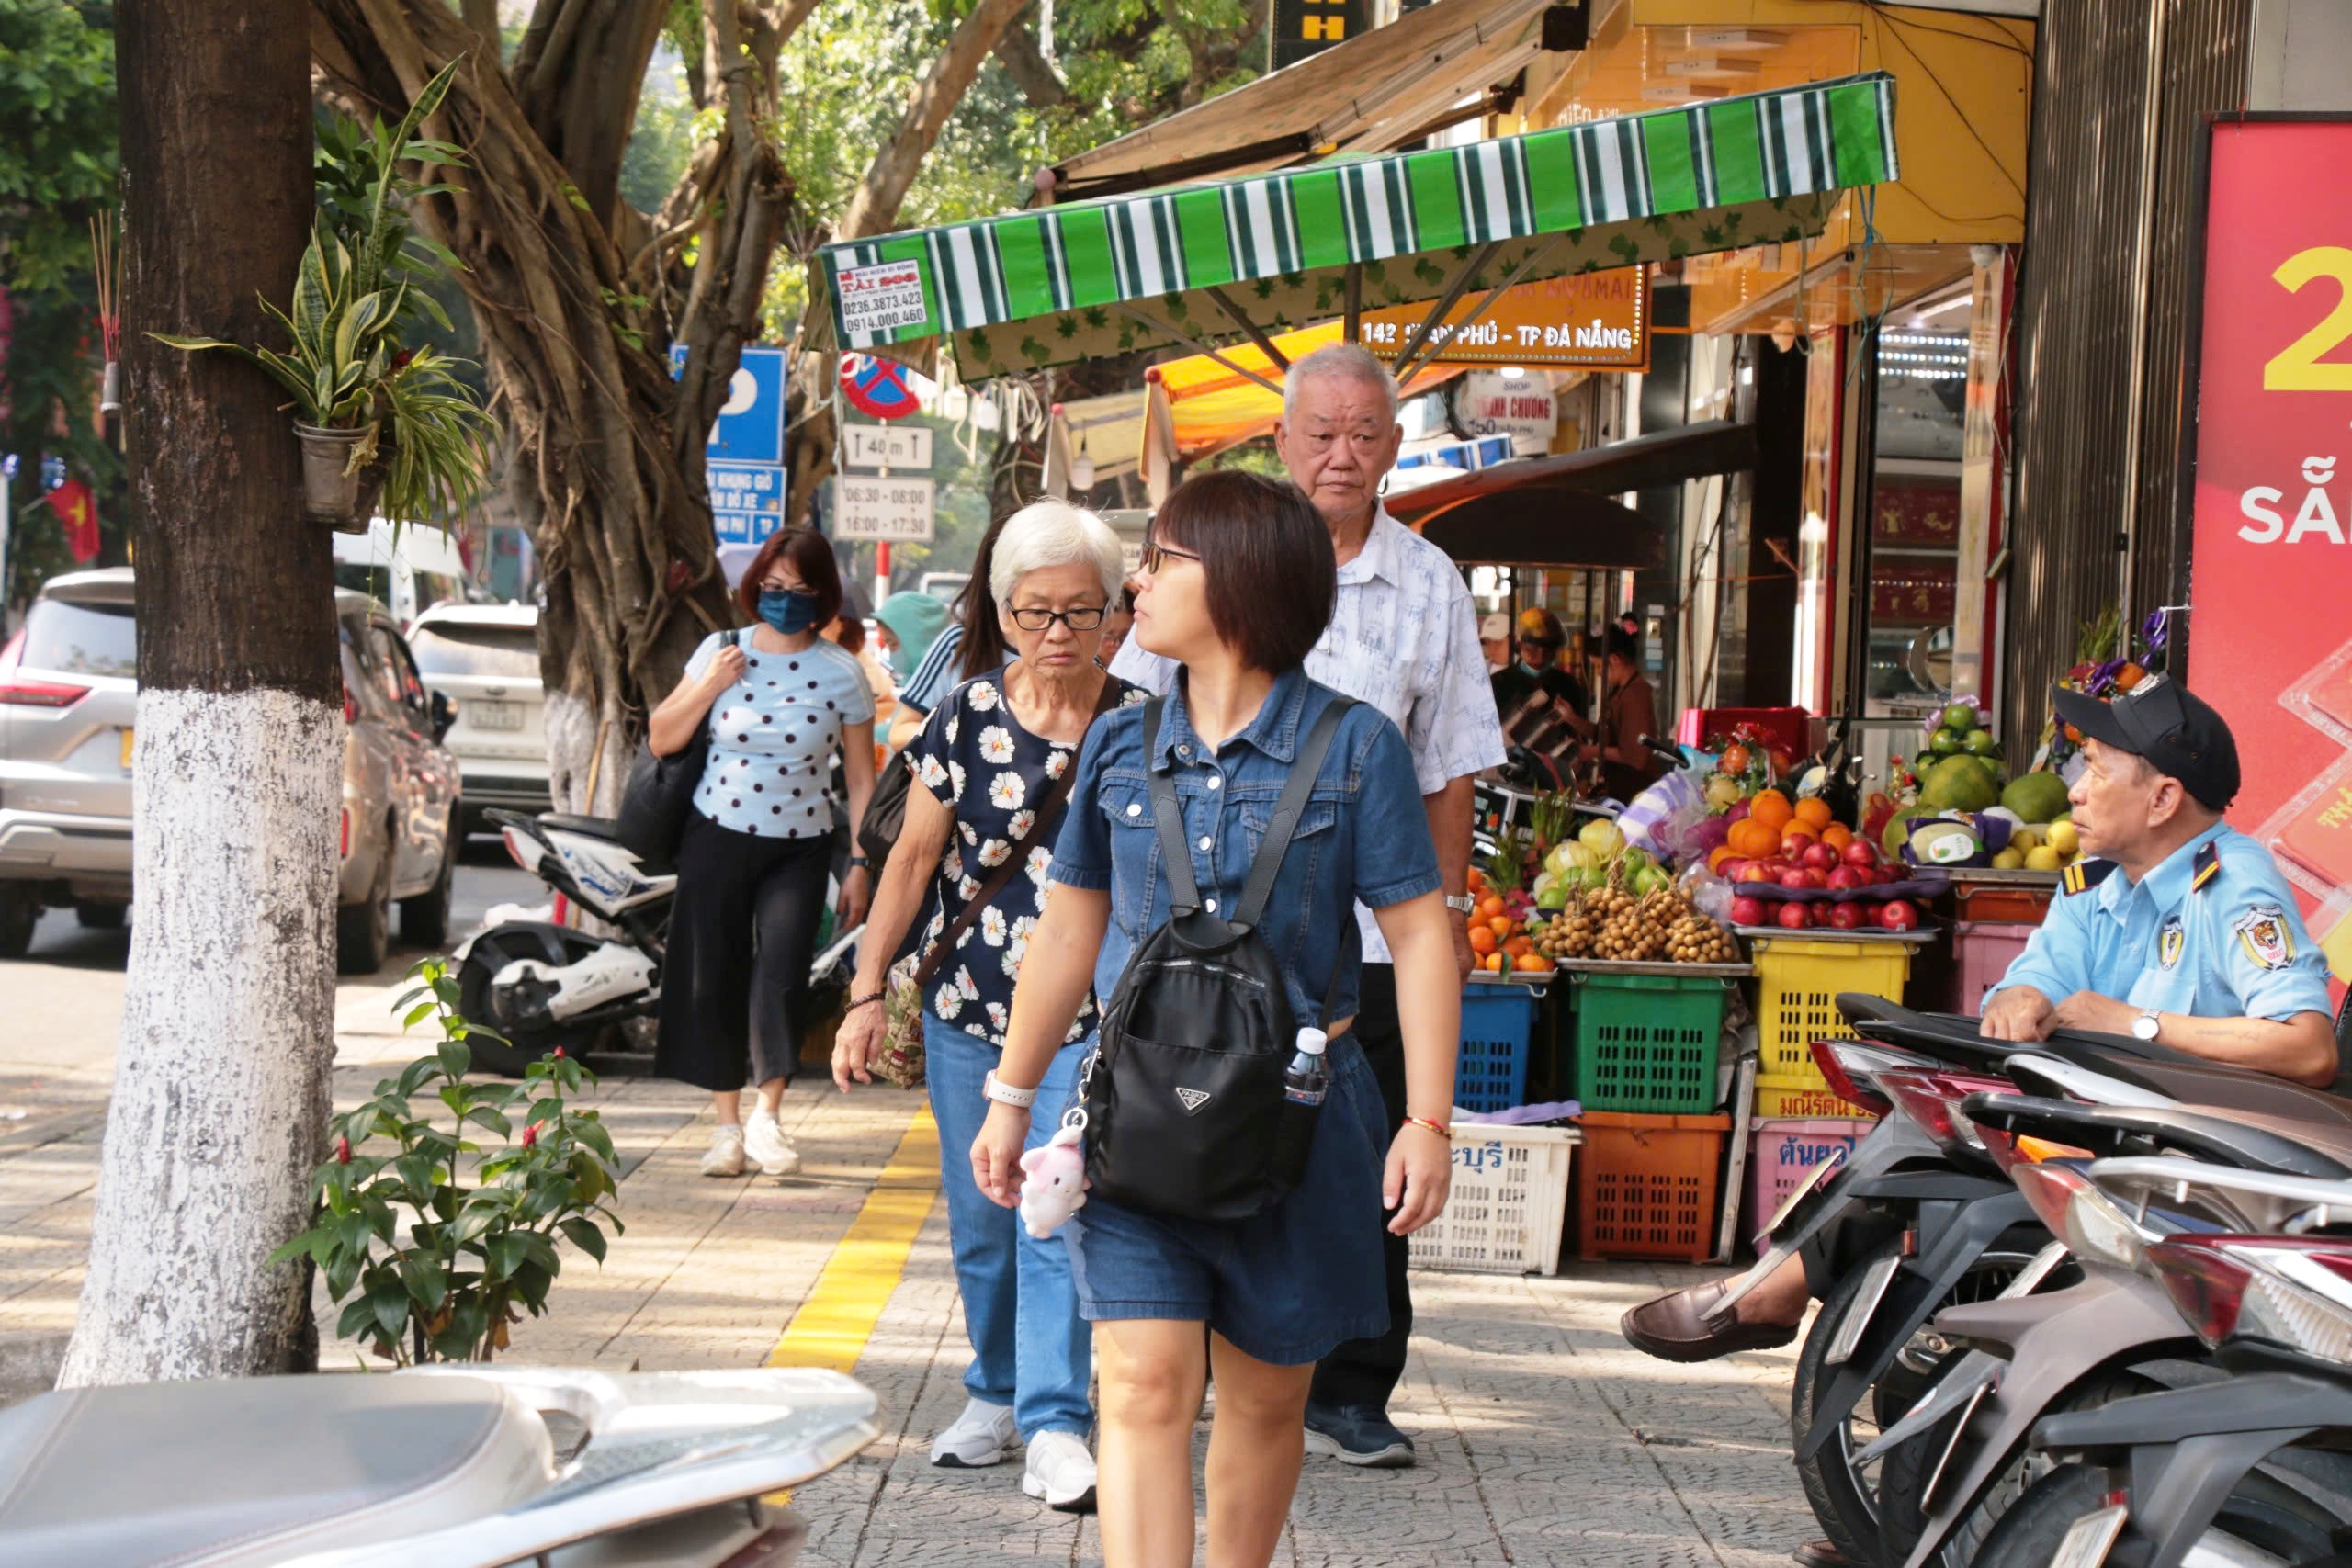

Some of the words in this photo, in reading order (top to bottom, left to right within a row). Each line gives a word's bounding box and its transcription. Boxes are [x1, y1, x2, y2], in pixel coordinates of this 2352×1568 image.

[843, 291, 922, 316] 0236.3873.423
[846, 308, 924, 333] 0914.000.460
[1363, 321, 1396, 344] 142
[1517, 324, 1543, 347] TP
[1575, 318, 1632, 350] NẴNG
[1503, 381, 1530, 391] SHOP
[867, 439, 887, 454] 40
[889, 443, 903, 455] m
[845, 487, 879, 502] 06:30
[2237, 455, 2352, 545] SẴ
[845, 516, 878, 531] 16:00
